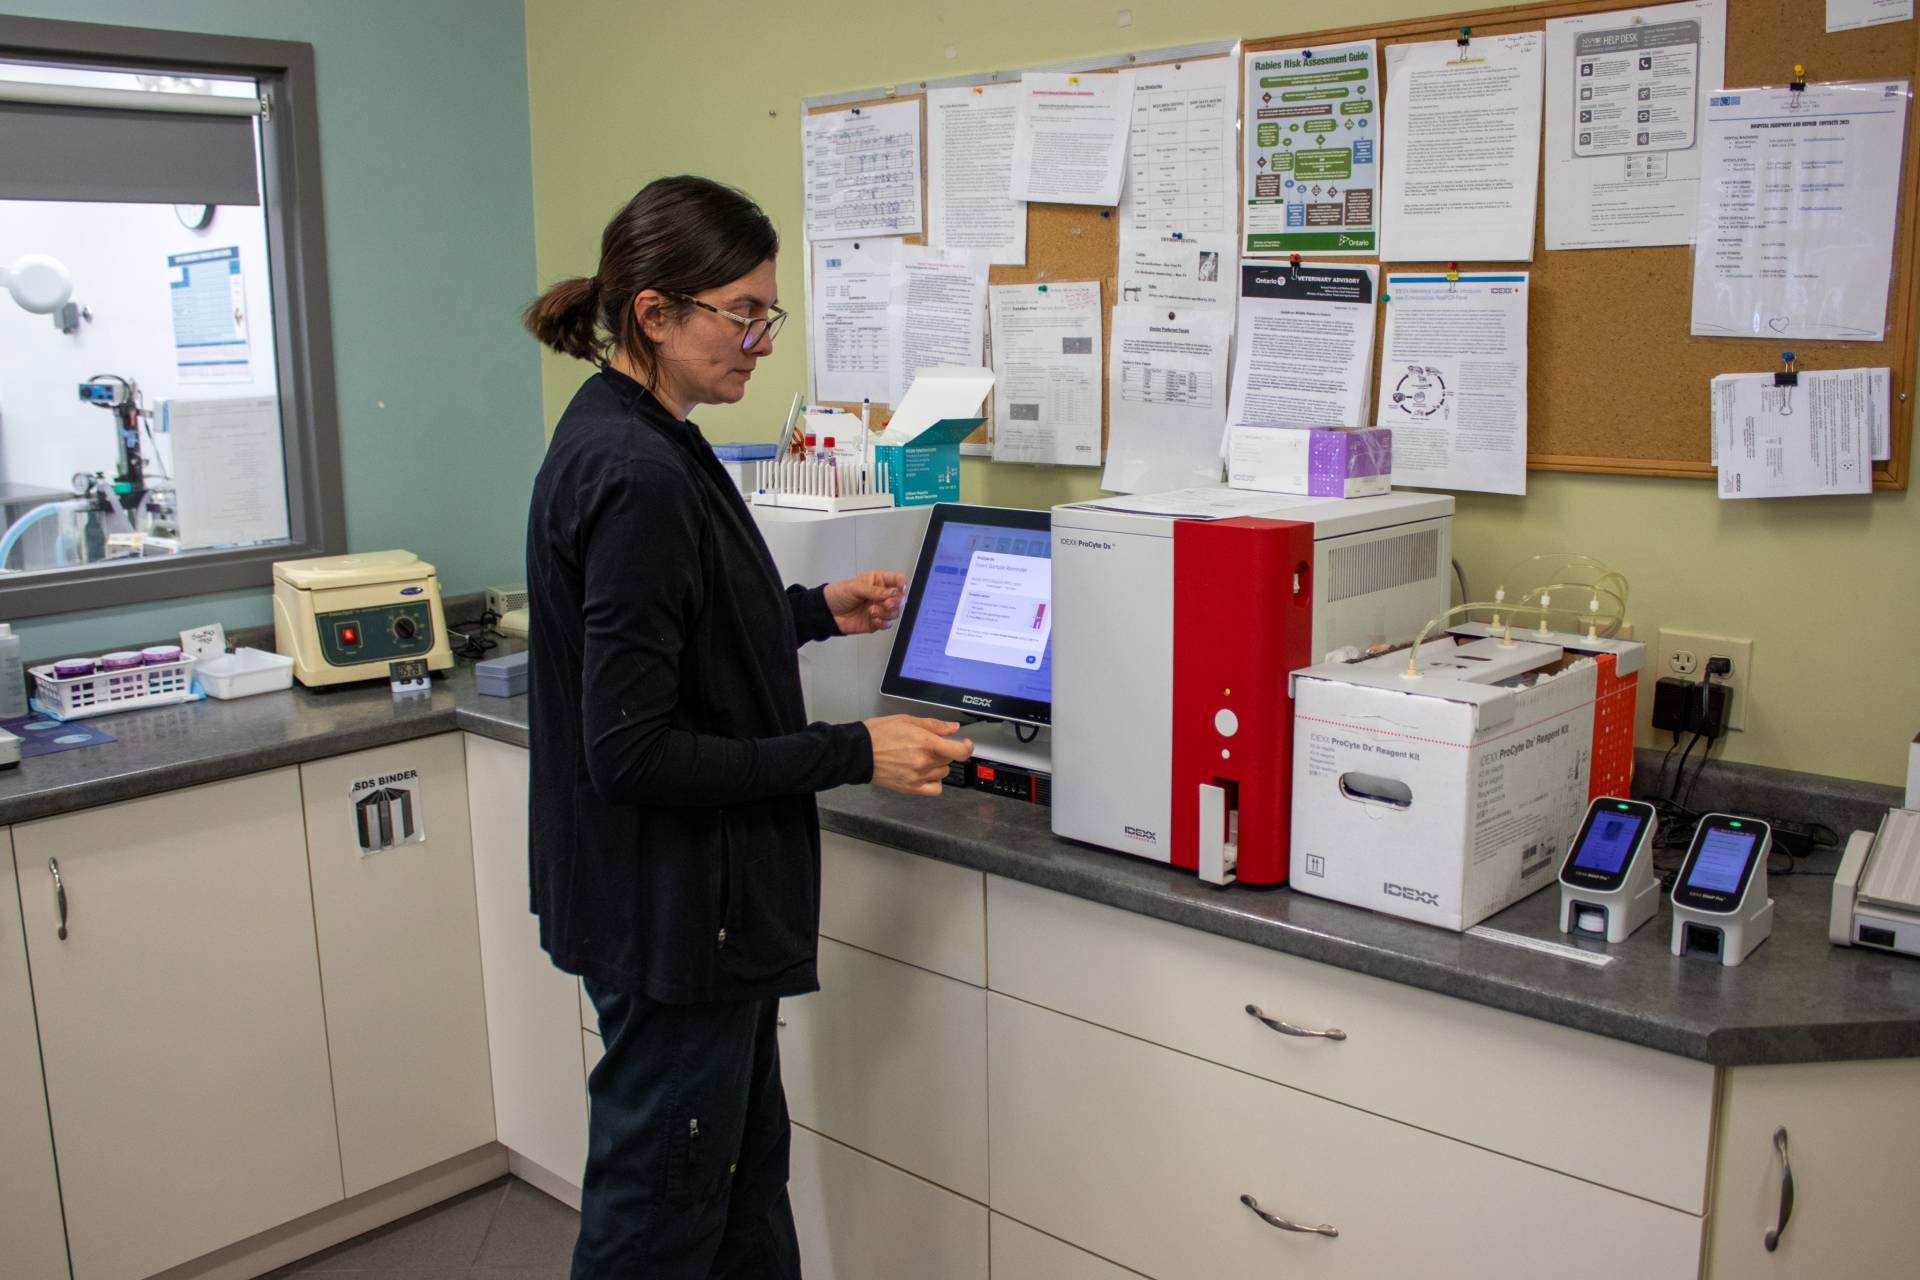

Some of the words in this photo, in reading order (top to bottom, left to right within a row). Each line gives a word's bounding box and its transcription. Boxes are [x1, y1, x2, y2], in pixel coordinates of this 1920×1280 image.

[1603, 35, 1620, 45] HELP
[1620, 33, 1638, 43] DESK
[1255, 61, 1282, 70] Rabies
[1284, 59, 1300, 68] Risk
[1303, 54, 1348, 67] Assessment
[1348, 51, 1368, 62] Guide
[1060, 538, 1077, 546] IDEXX
[1078, 540, 1102, 549] ProCyte
[962, 694, 992, 708] IDEXX
[1310, 733, 1330, 744] IDEXX
[1331, 737, 1361, 751] ProCyte
[1376, 746, 1408, 759] Reagent
[1409, 750, 1420, 761] Kit
[1480, 752, 1498, 767] IDEXX
[1500, 742, 1525, 760] ProCyte
[1536, 728, 1560, 744] Reagent
[1560, 724, 1569, 736] Kit
[354, 779, 376, 791] SDS
[378, 770, 418, 786] BINDER
[1124, 826, 1157, 840] IDEXX
[1384, 882, 1440, 907] IDEXX
